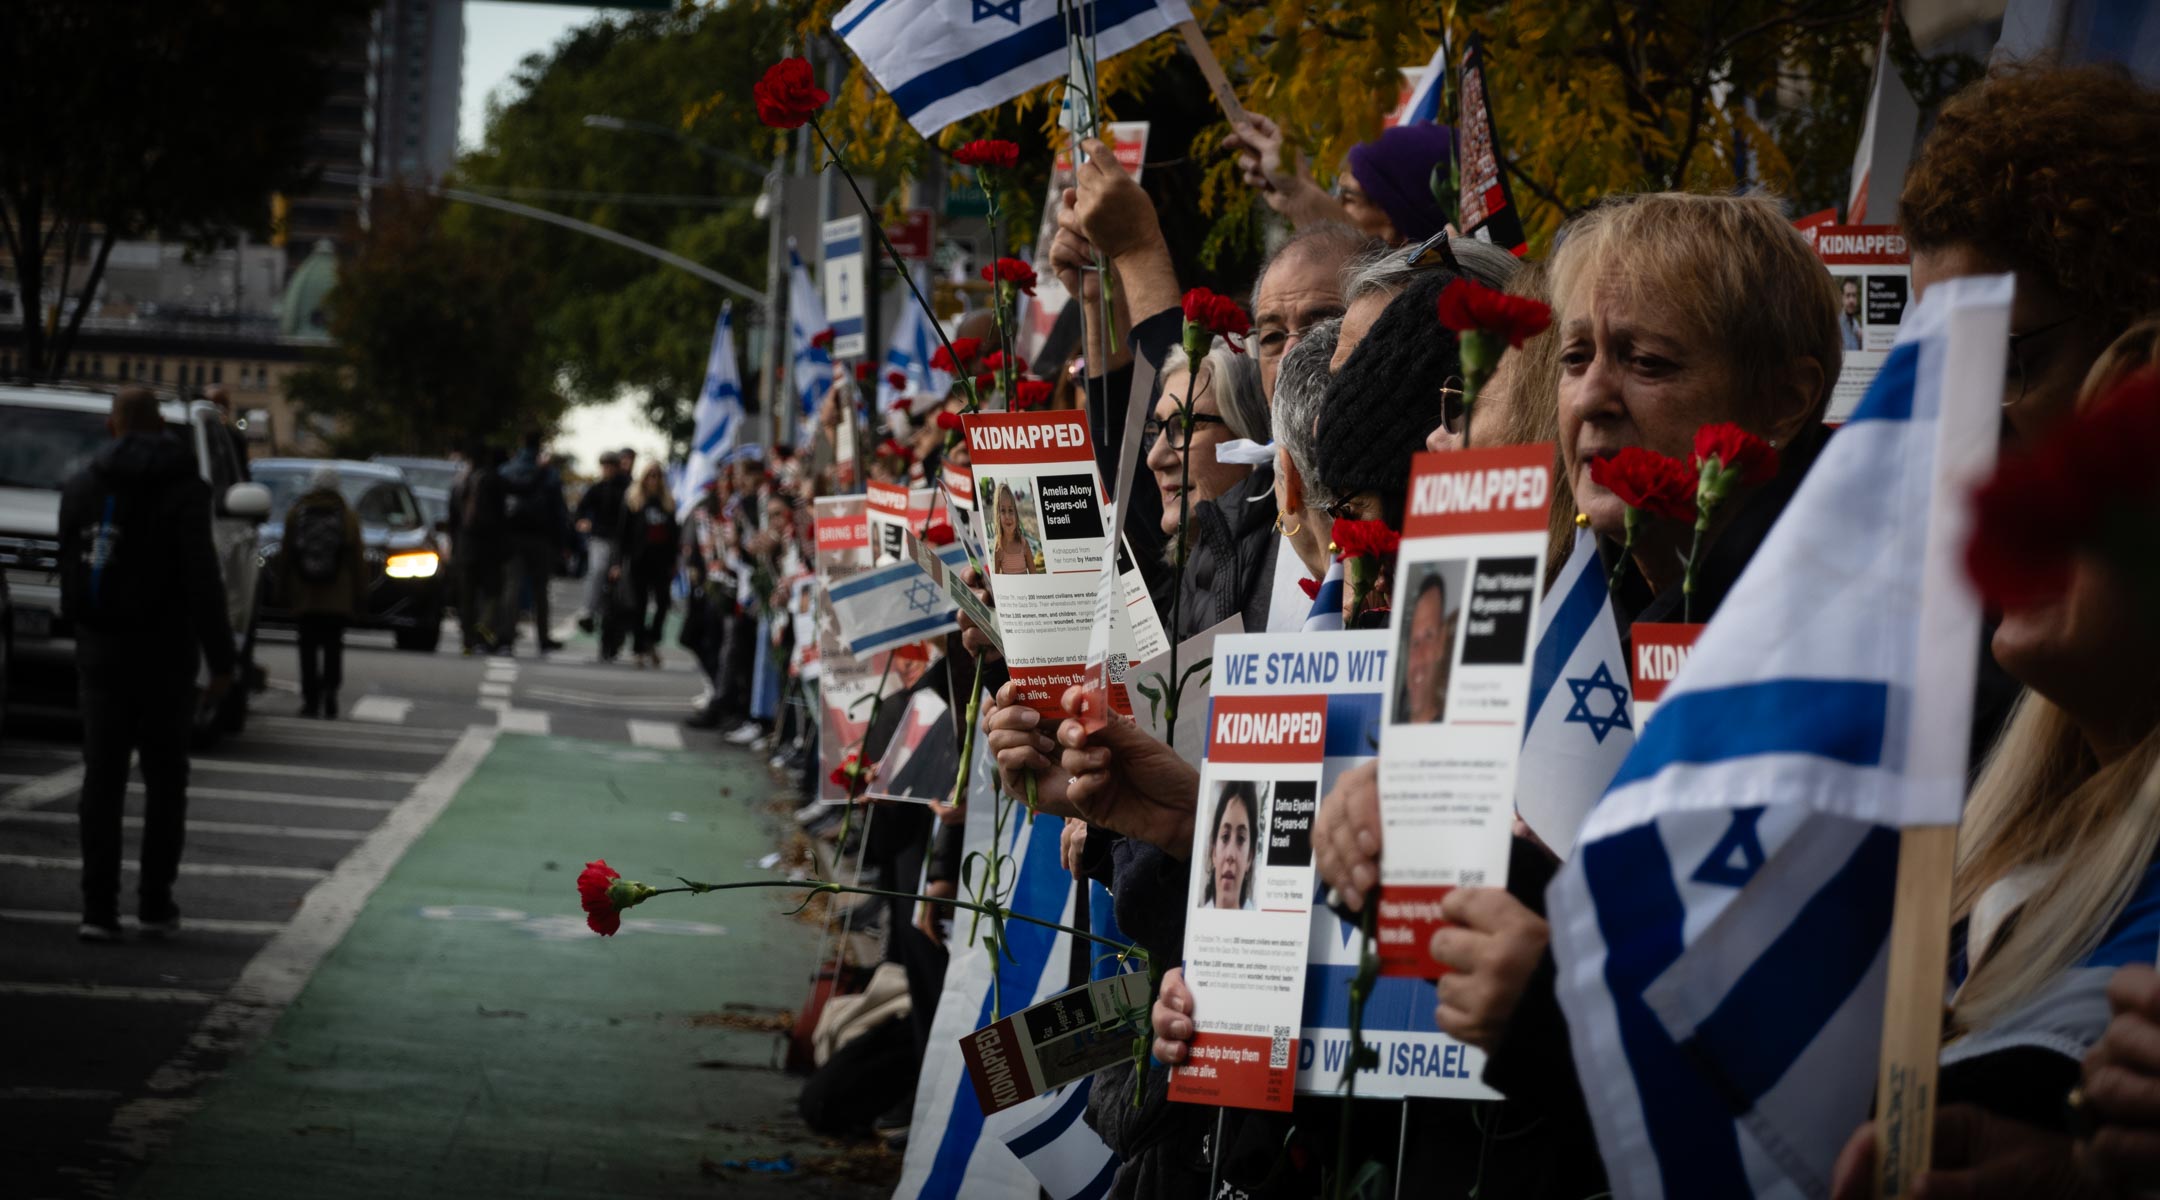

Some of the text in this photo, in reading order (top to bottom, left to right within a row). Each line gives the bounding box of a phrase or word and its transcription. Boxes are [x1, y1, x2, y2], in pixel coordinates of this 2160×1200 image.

[1819, 234, 1906, 255] KIDNAPPED
[970, 423, 1085, 450] KIDNAPPED
[1042, 484, 1092, 497] Amelia Alony
[1410, 465, 1549, 516] KIDNAPPED
[1044, 499, 1087, 513] 5-years-old
[1046, 513, 1071, 525] Israeli
[819, 525, 850, 542] BRING
[854, 523, 868, 539] ED
[1077, 556, 1084, 564] by
[1085, 554, 1103, 562] Hamas
[1016, 657, 1029, 665] photo
[1047, 655, 1064, 664] poster
[1226, 649, 1388, 686] WE STAND WIT
[1011, 673, 1085, 687] ase help bring the
[1028, 689, 1050, 700] alive.
[1215, 711, 1322, 744] KIDNAPPED
[1275, 798, 1293, 811] Dafna
[1273, 816, 1309, 832] 15-years-old
[1271, 834, 1290, 848] Israeli
[1206, 1045, 1221, 1062] help
[1222, 1045, 1241, 1064] bring
[1241, 1048, 1260, 1062] them
[1388, 1041, 1470, 1079] ISRAEL
[975, 1027, 1019, 1107] KIDNAPPED
[1199, 1064, 1218, 1078] alive.
